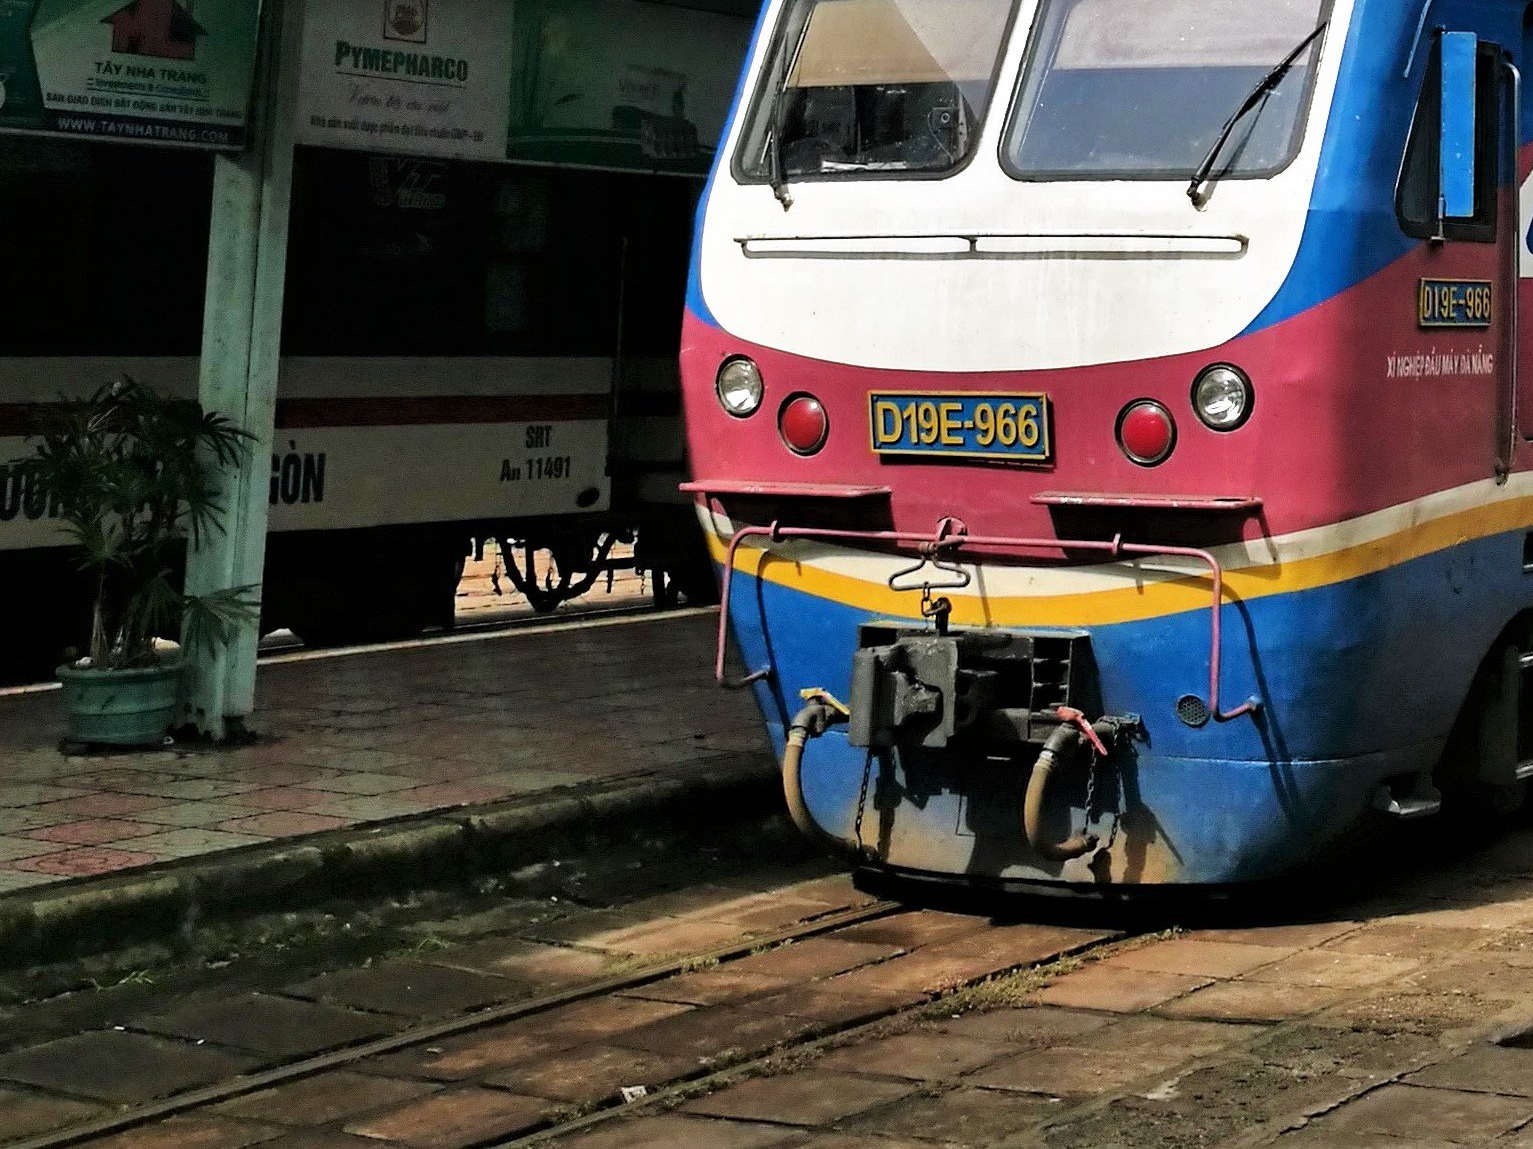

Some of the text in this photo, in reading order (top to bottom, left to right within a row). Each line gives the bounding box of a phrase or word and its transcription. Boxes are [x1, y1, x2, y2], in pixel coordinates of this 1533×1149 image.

[94, 60, 207, 85] TÂY NHA TRANG
[335, 40, 469, 82] PYMEPHARCO
[1423, 285, 1491, 319] D19E-966
[525, 424, 552, 448] SRT
[875, 400, 1040, 448] D19E-966
[526, 455, 571, 480] 11491
